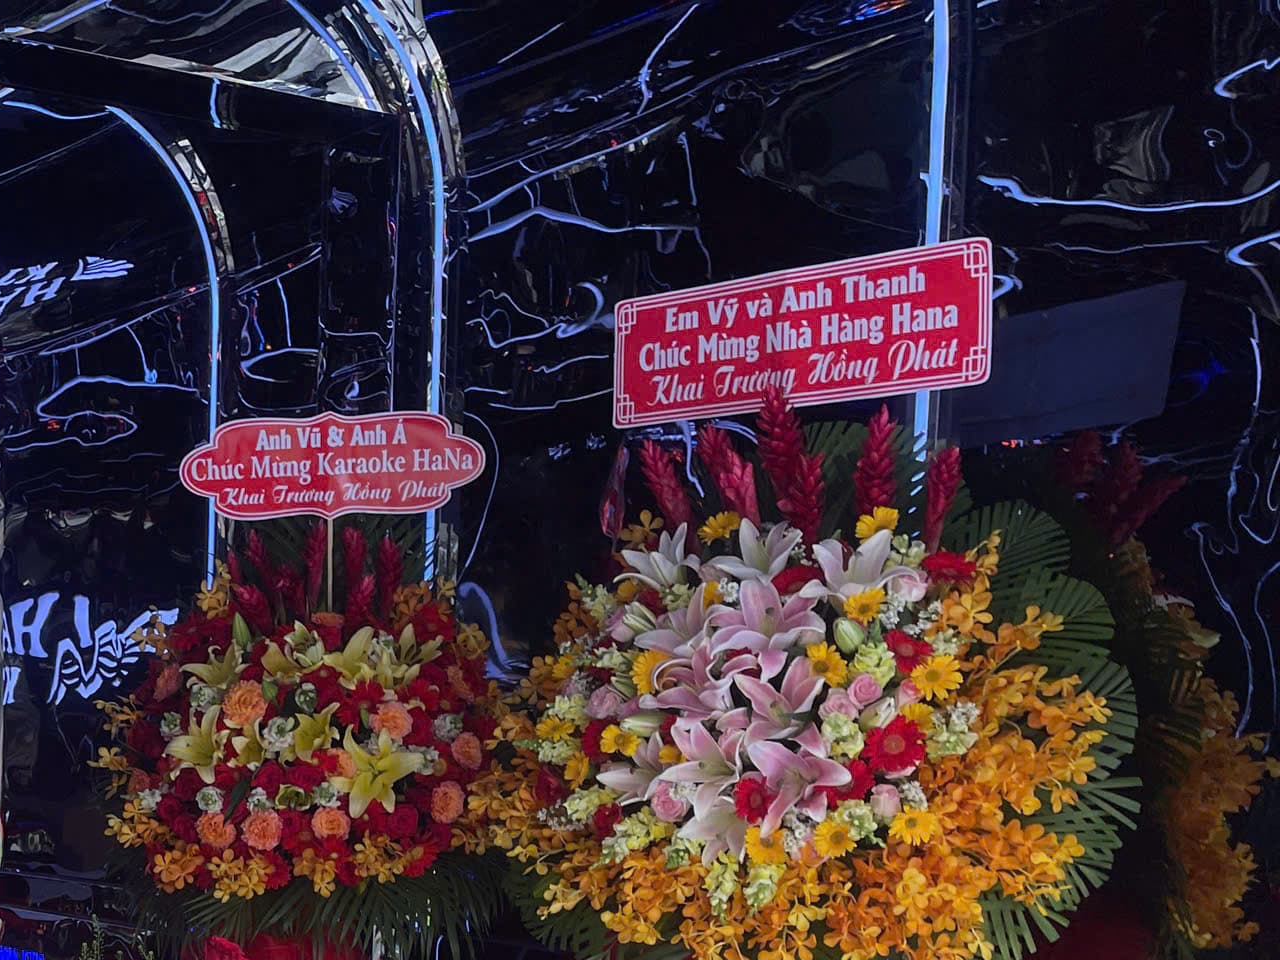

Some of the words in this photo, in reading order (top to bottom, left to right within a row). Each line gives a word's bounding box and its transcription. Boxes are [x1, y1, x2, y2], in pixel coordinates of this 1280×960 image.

[665, 307, 699, 333] Em
[708, 298, 738, 328] Vỹ
[746, 292, 773, 319] và
[780, 284, 832, 314] Anh
[841, 266, 926, 304] Thanh
[639, 339, 691, 372] Chúc
[697, 331, 760, 364] Mừng
[766, 319, 811, 354] Nhà
[820, 311, 884, 345] Hàng
[892, 302, 958, 336] Hana
[646, 374, 704, 407] Khai
[713, 364, 797, 398] Trương
[807, 347, 879, 386] Hồng
[888, 338, 959, 381] Phát
[255, 428, 292, 451] Anh
[296, 427, 321, 448] Vũ
[326, 426, 345, 447] &
[349, 424, 387, 447] Anh
[191, 458, 245, 483] Chúc
[250, 453, 312, 485] Mừng
[317, 450, 407, 477] Karaoke
[412, 447, 473, 473] HaNa
[220, 487, 265, 506] Khai
[272, 484, 334, 505] Trương
[397, 480, 448, 502] Phát
